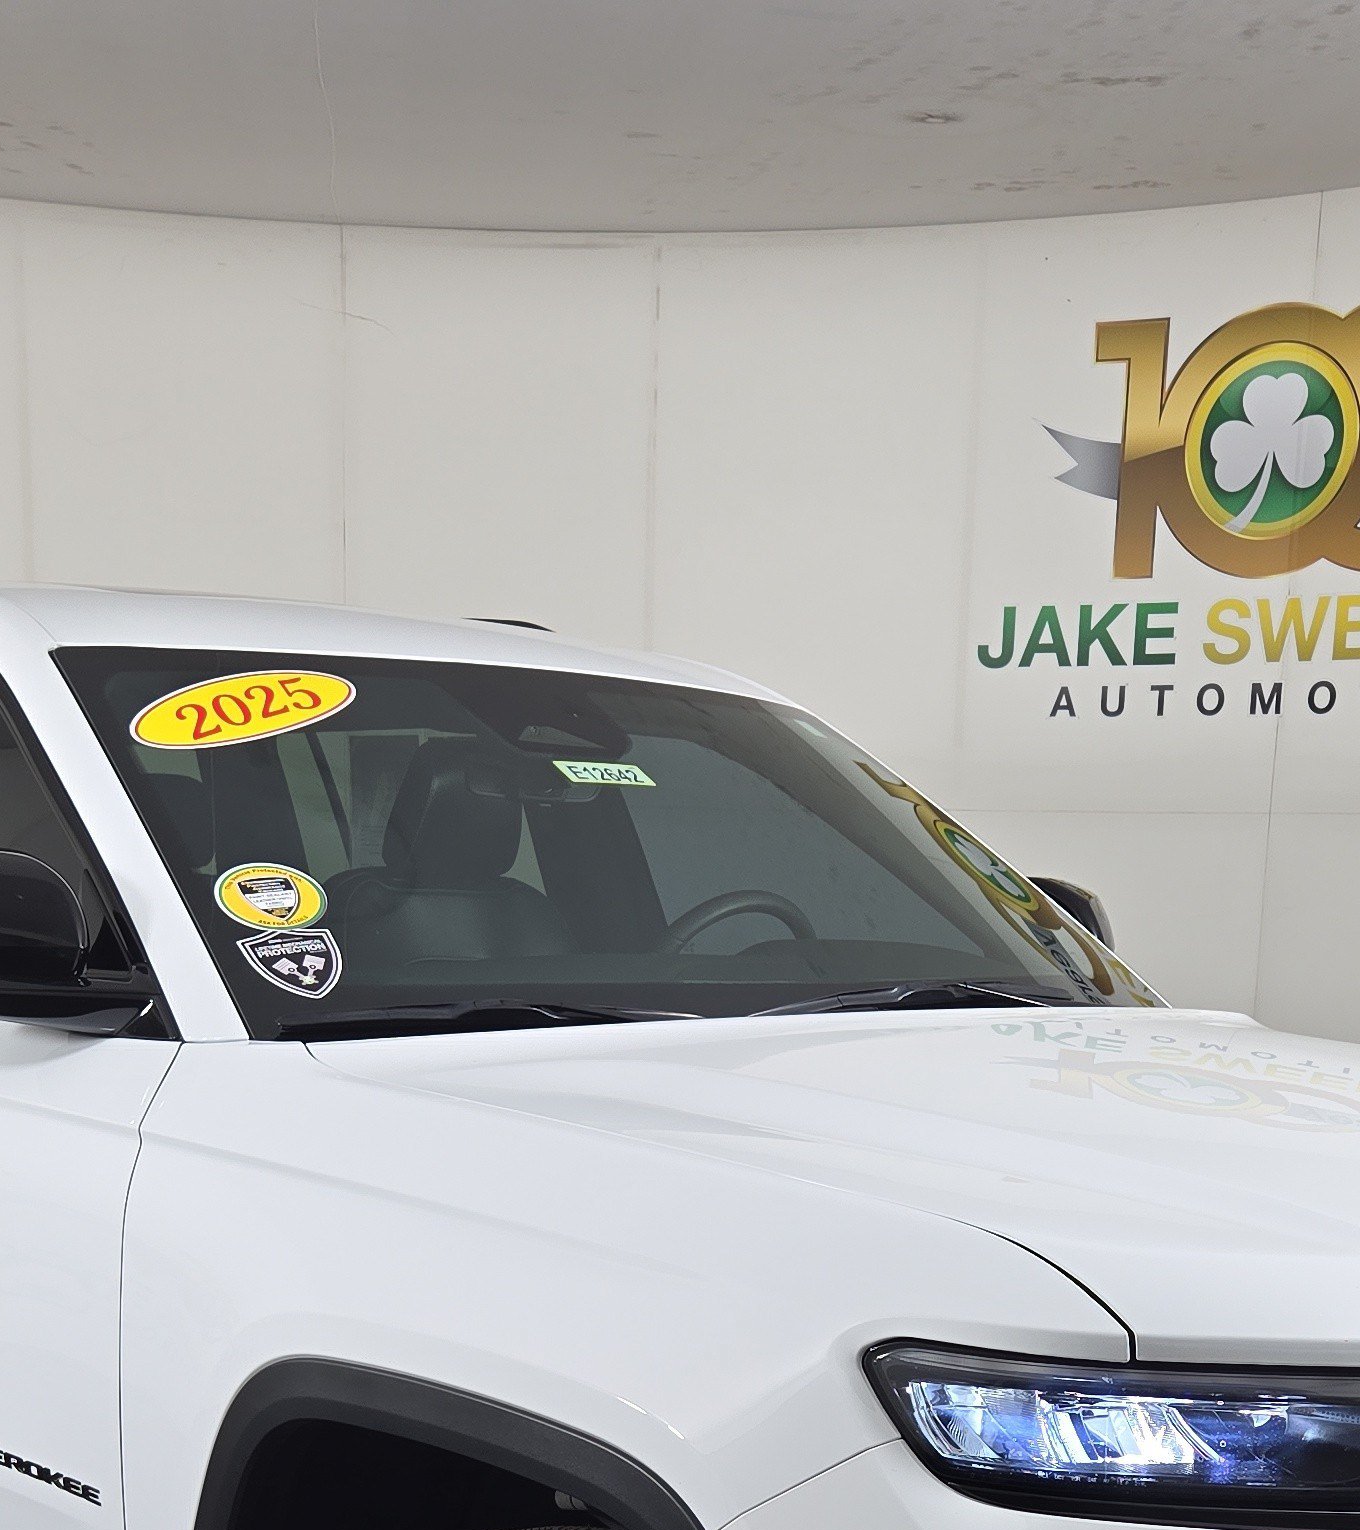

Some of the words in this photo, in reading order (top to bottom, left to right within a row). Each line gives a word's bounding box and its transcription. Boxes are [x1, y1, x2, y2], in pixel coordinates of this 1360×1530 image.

[977, 601, 1180, 669] JAKE
[175, 678, 324, 741] 2025
[566, 765, 645, 784] E12642
[256, 943, 327, 958] PROTECTION
